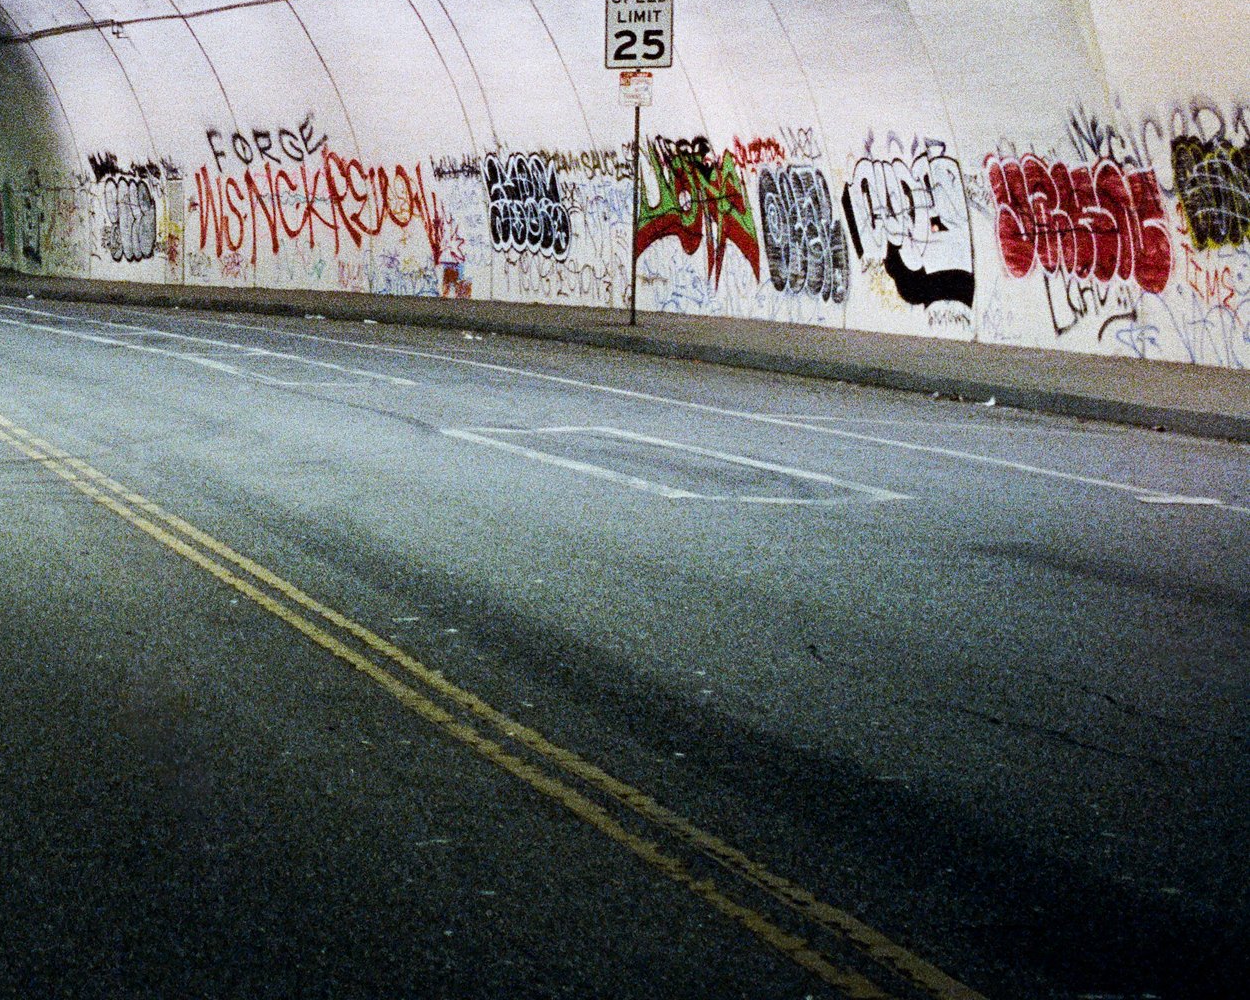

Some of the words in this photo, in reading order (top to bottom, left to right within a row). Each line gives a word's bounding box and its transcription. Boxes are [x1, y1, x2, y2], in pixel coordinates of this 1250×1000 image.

[617, 10, 662, 22] LIMIT
[613, 29, 665, 60] 25
[206, 113, 328, 172] FORGE
